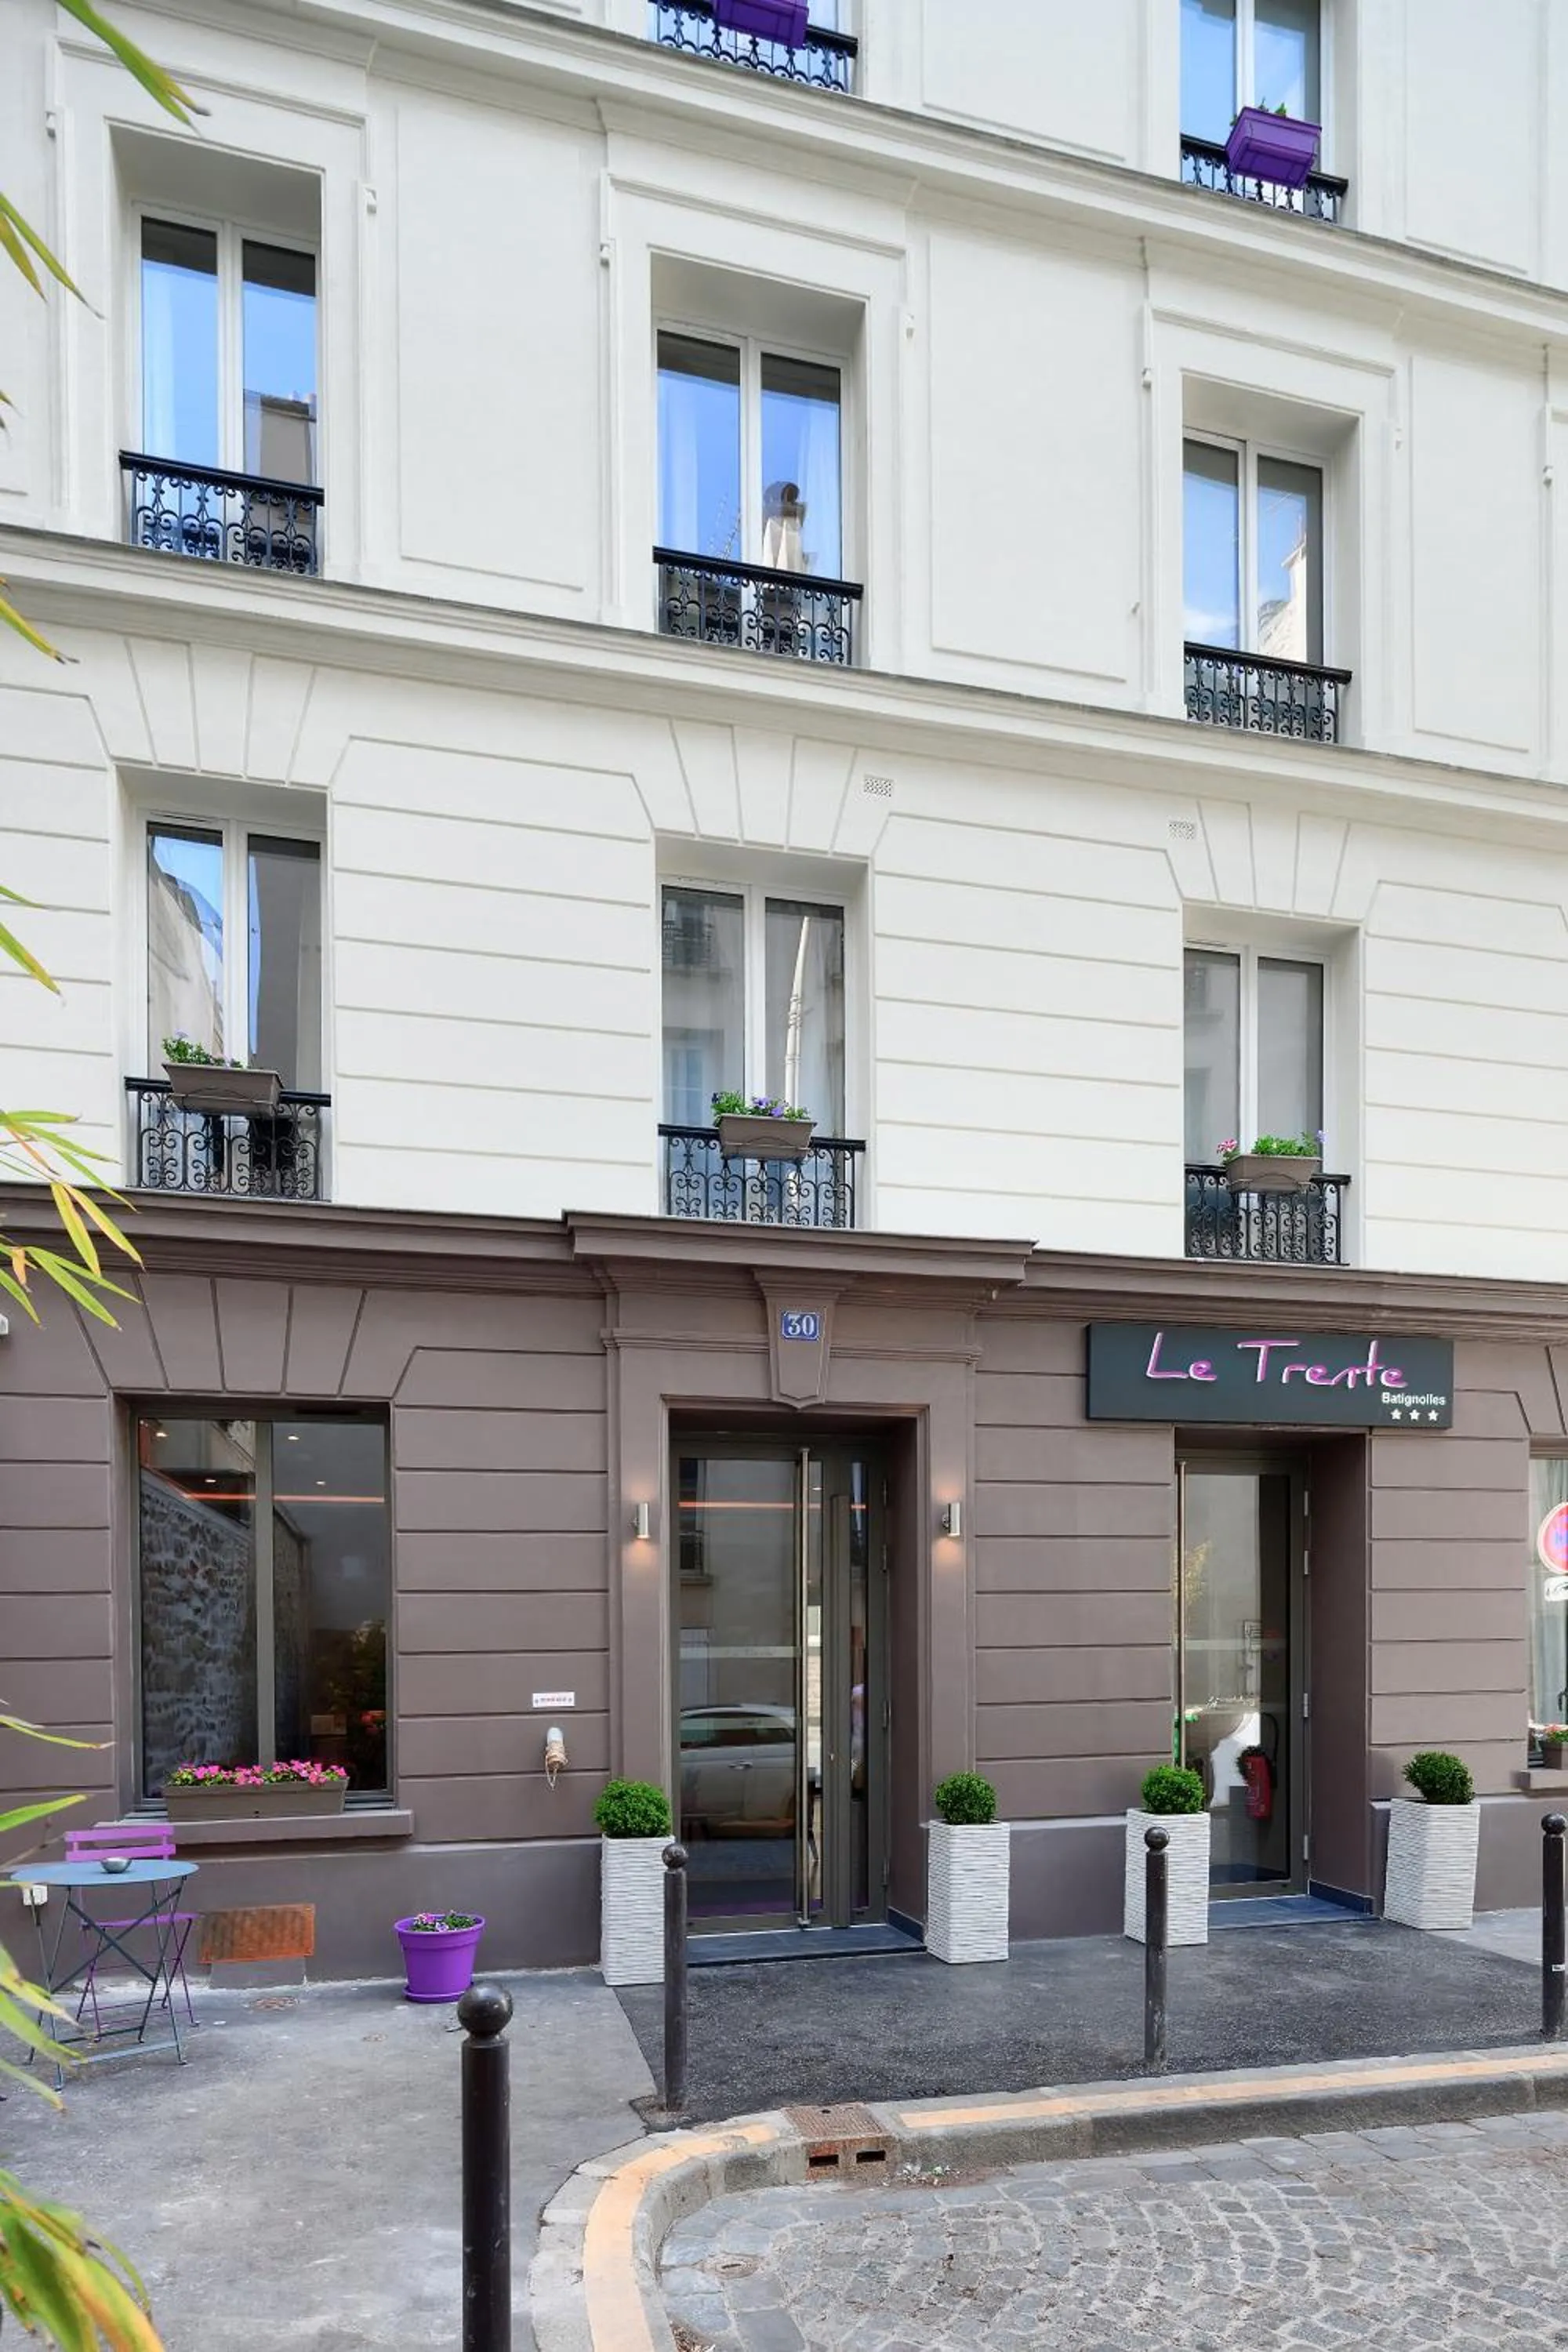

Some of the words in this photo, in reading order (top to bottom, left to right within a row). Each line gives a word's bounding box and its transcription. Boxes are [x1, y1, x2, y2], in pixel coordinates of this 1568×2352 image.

[788, 1314, 815, 1336] 30
[1145, 1332, 1218, 1381] Le
[1236, 1339, 1408, 1388] Trente
[1381, 1391, 1446, 1407] Batignolles
